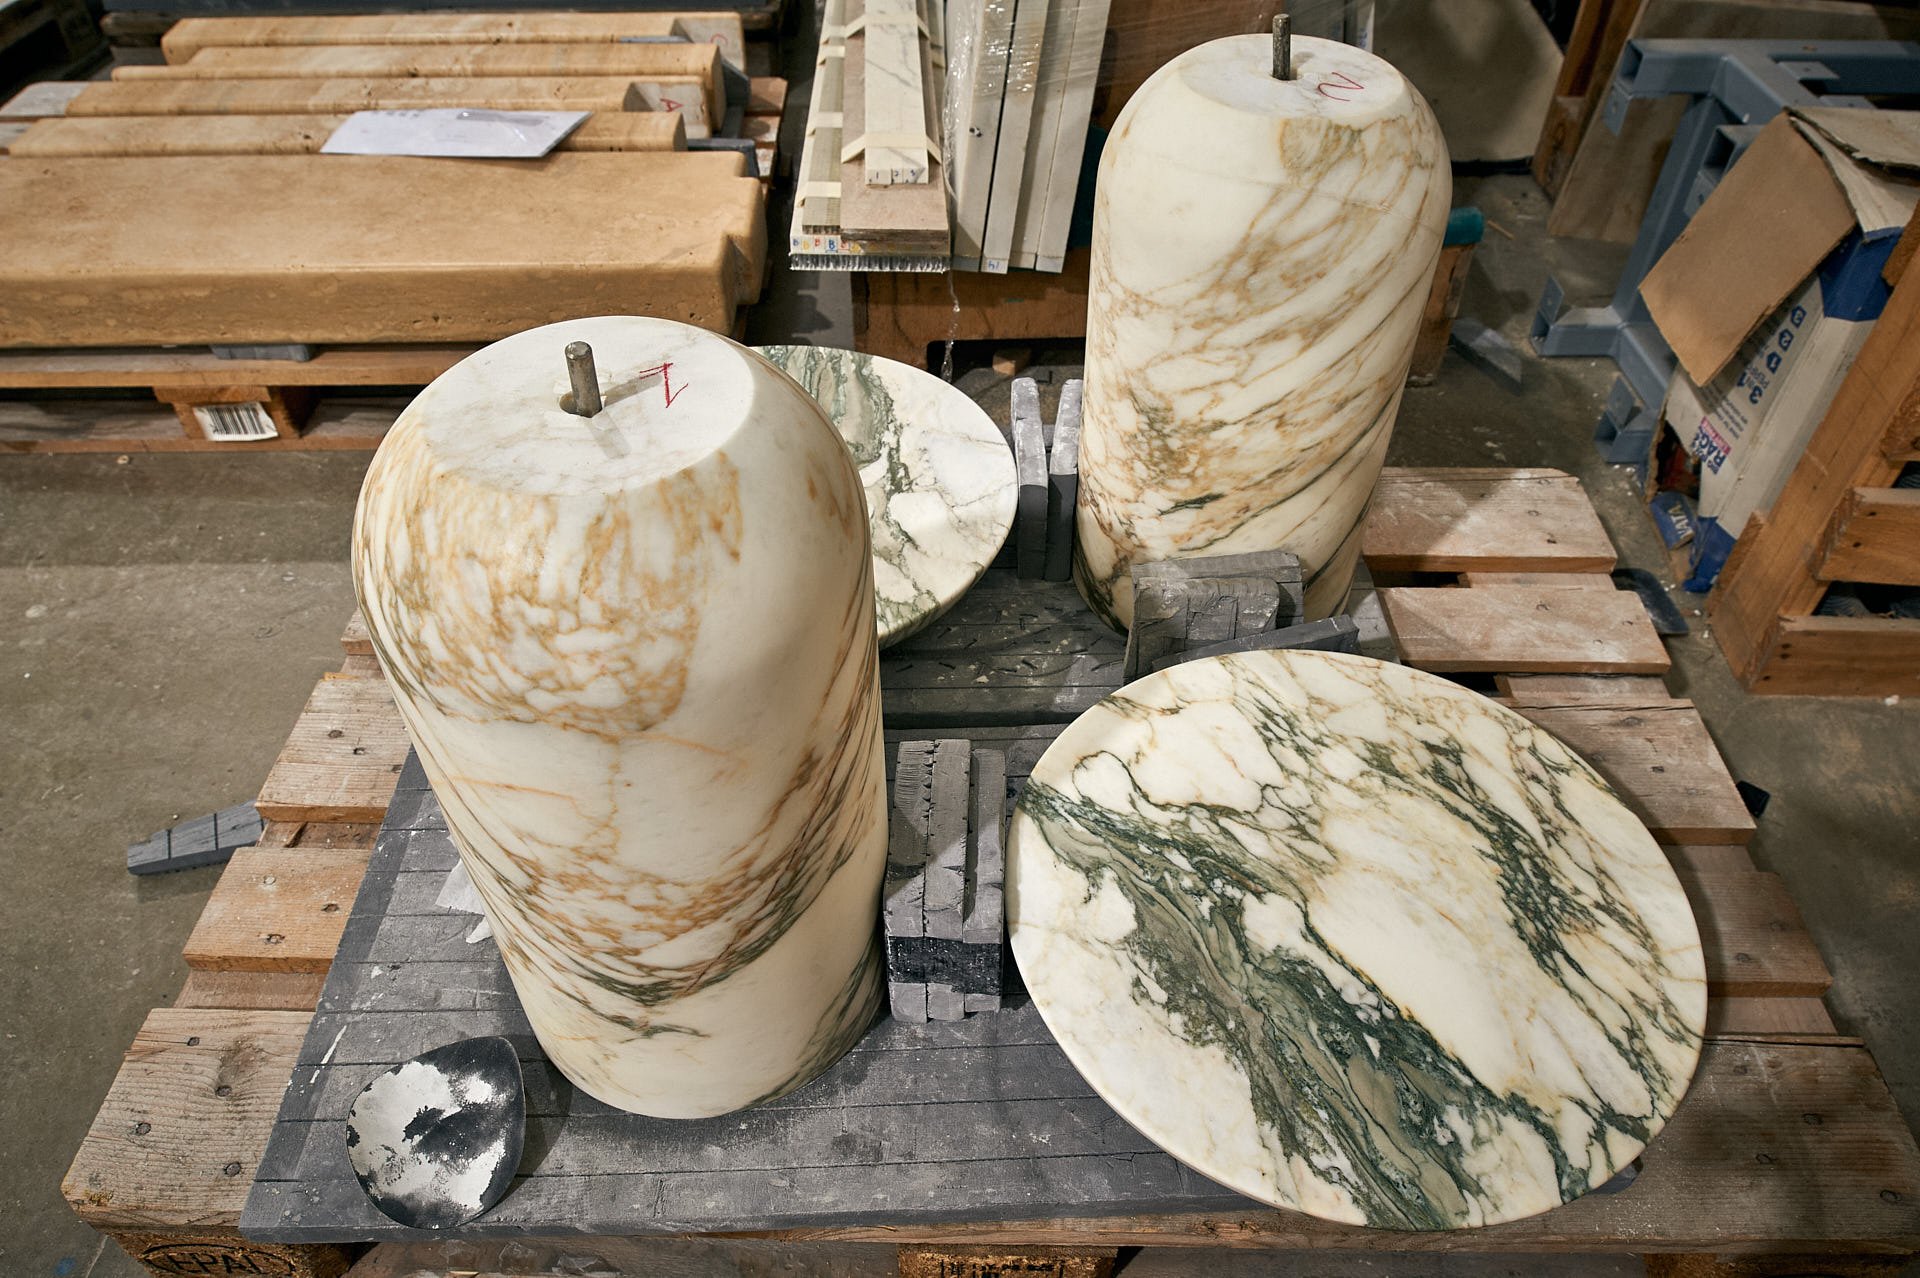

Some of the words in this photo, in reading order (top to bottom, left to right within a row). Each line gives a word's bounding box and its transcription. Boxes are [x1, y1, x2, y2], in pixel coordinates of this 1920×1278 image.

[659, 97, 684, 113] A
[1749, 385, 1763, 404] 3
[166, 1251, 266, 1276] EPAL
